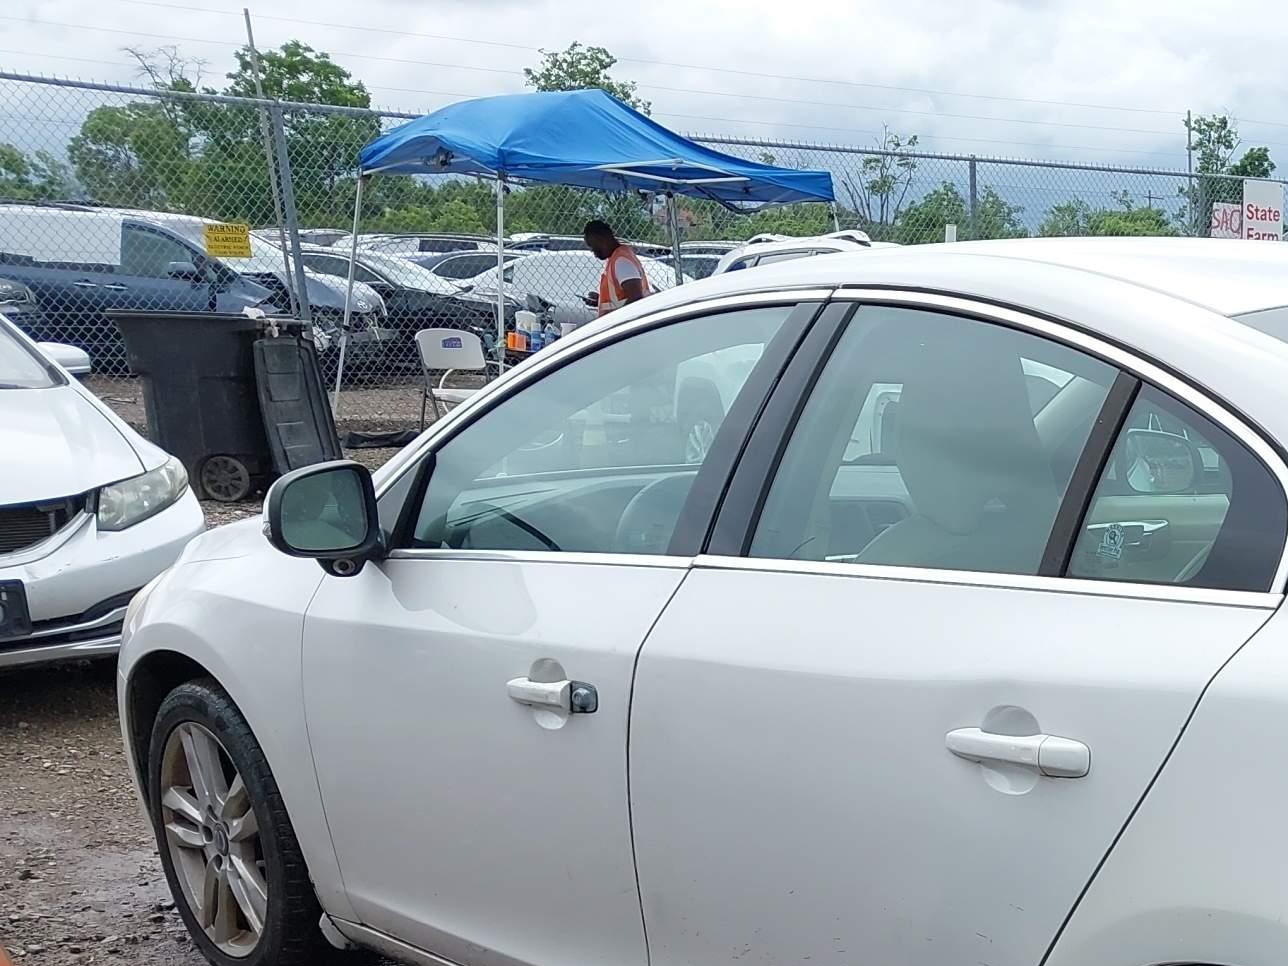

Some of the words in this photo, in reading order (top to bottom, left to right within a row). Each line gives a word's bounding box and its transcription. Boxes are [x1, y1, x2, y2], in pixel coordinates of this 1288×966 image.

[1246, 203, 1281, 222] State
[207, 224, 246, 234] WARNING
[1246, 227, 1280, 240] Farm
